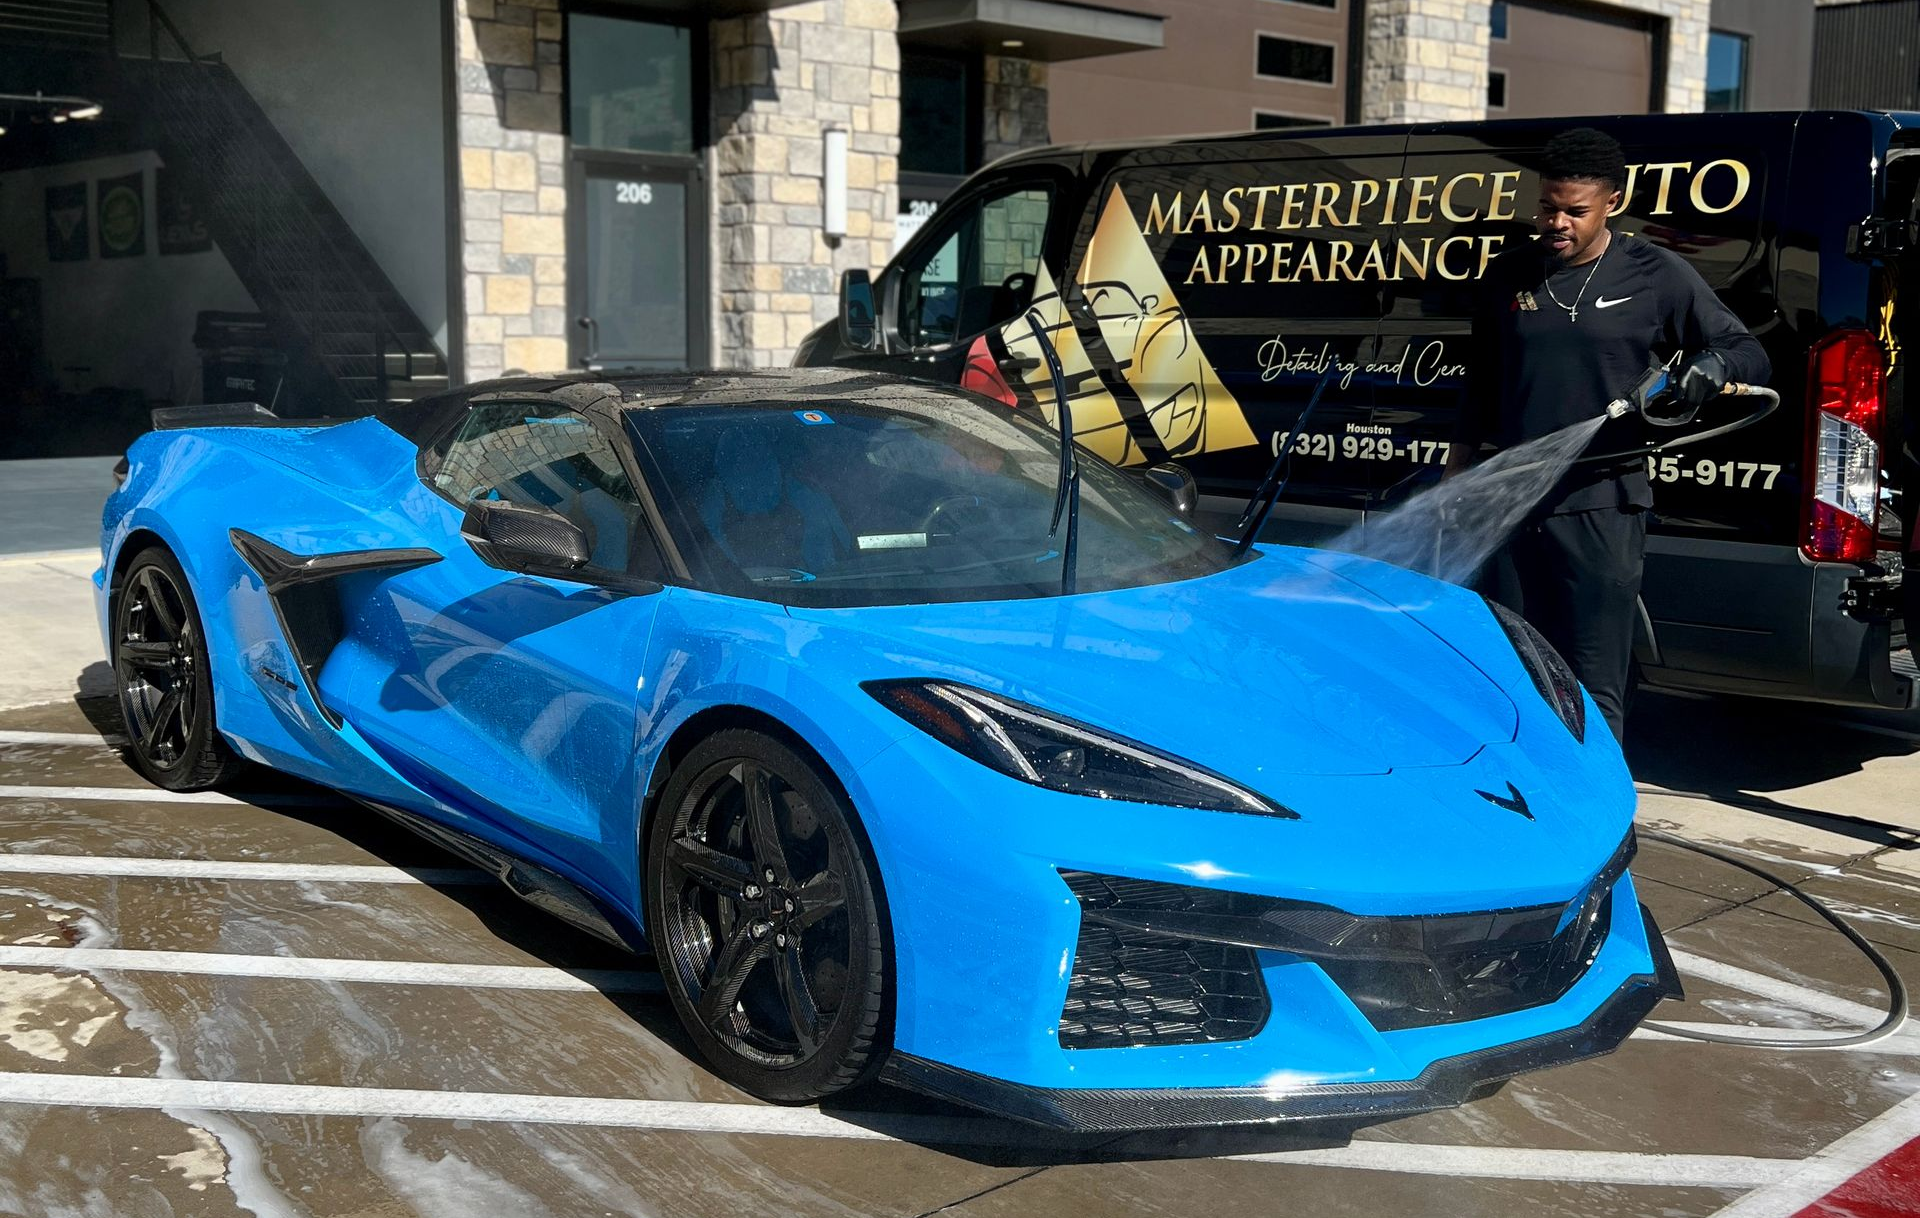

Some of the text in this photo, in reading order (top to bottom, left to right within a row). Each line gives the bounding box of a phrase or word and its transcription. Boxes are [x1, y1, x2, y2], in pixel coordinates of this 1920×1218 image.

[615, 182, 653, 204] 206
[1141, 169, 1521, 236] MASTERPIECE
[1365, 344, 1411, 384] and
[1346, 423, 1392, 435] Houston
